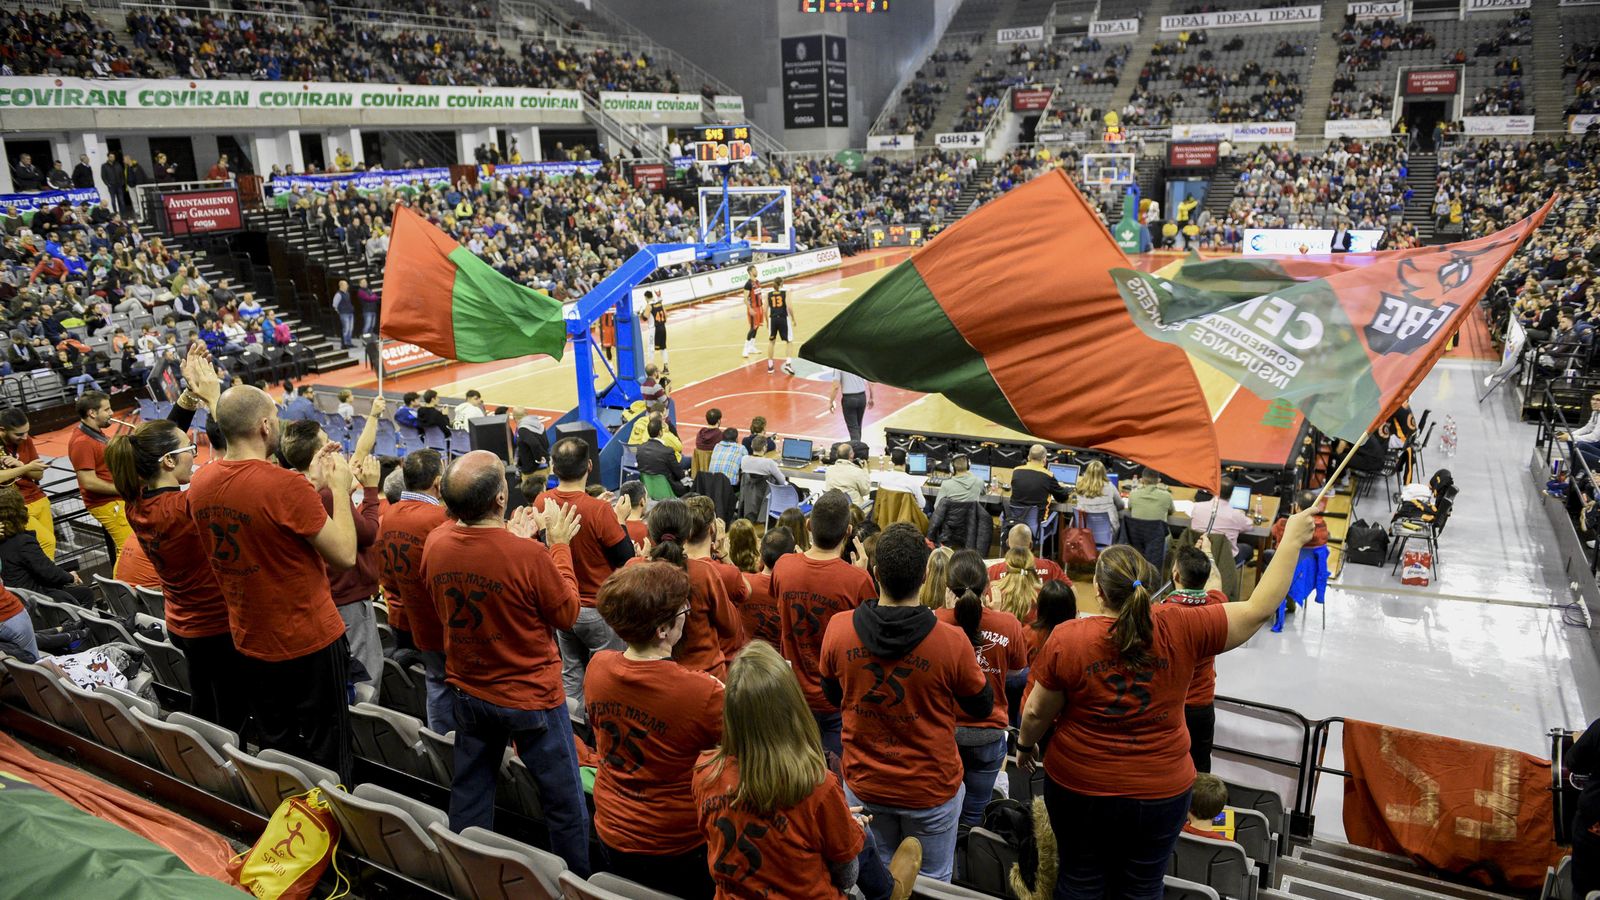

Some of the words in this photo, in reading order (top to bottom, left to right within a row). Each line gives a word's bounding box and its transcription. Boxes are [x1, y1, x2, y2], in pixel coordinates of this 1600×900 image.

[1166, 16, 1209, 28] IDEAL
[1216, 12, 1262, 24] IDEAL
[1269, 8, 1317, 21] IDEAL
[1351, 4, 1399, 15] IDEAL
[1001, 29, 1039, 41] IDEAL
[1093, 21, 1135, 33] IDEAL
[138, 89, 250, 107] COVIRAN
[258, 91, 353, 107] COVIRAN
[360, 92, 440, 108] COVIRAN
[446, 94, 515, 109] COVIRAN
[520, 95, 579, 110] COVIRAN
[603, 98, 653, 111] COVIRAN
[656, 100, 700, 112] COVIRAN
[67, 192, 99, 202] PULEVA
[168, 196, 234, 209] AYUNTAMIENTO
[189, 207, 230, 219] GRANADA
[762, 266, 786, 277] COVIRAN
[771, 294, 784, 308] 13
[382, 343, 419, 360] GRUPO
[208, 522, 241, 563] 25
[388, 542, 411, 576] 25
[433, 572, 464, 588] FRENTE
[466, 572, 504, 596] MAZARI
[783, 591, 810, 602] FRENTE
[444, 586, 488, 631] 25
[790, 602, 827, 638] 25
[861, 662, 914, 708] 25
[1103, 672, 1153, 716] 25
[625, 705, 668, 736] MAZARI
[599, 719, 649, 775] 25
[713, 815, 769, 883] 25
[262, 851, 287, 877] SPAIN
